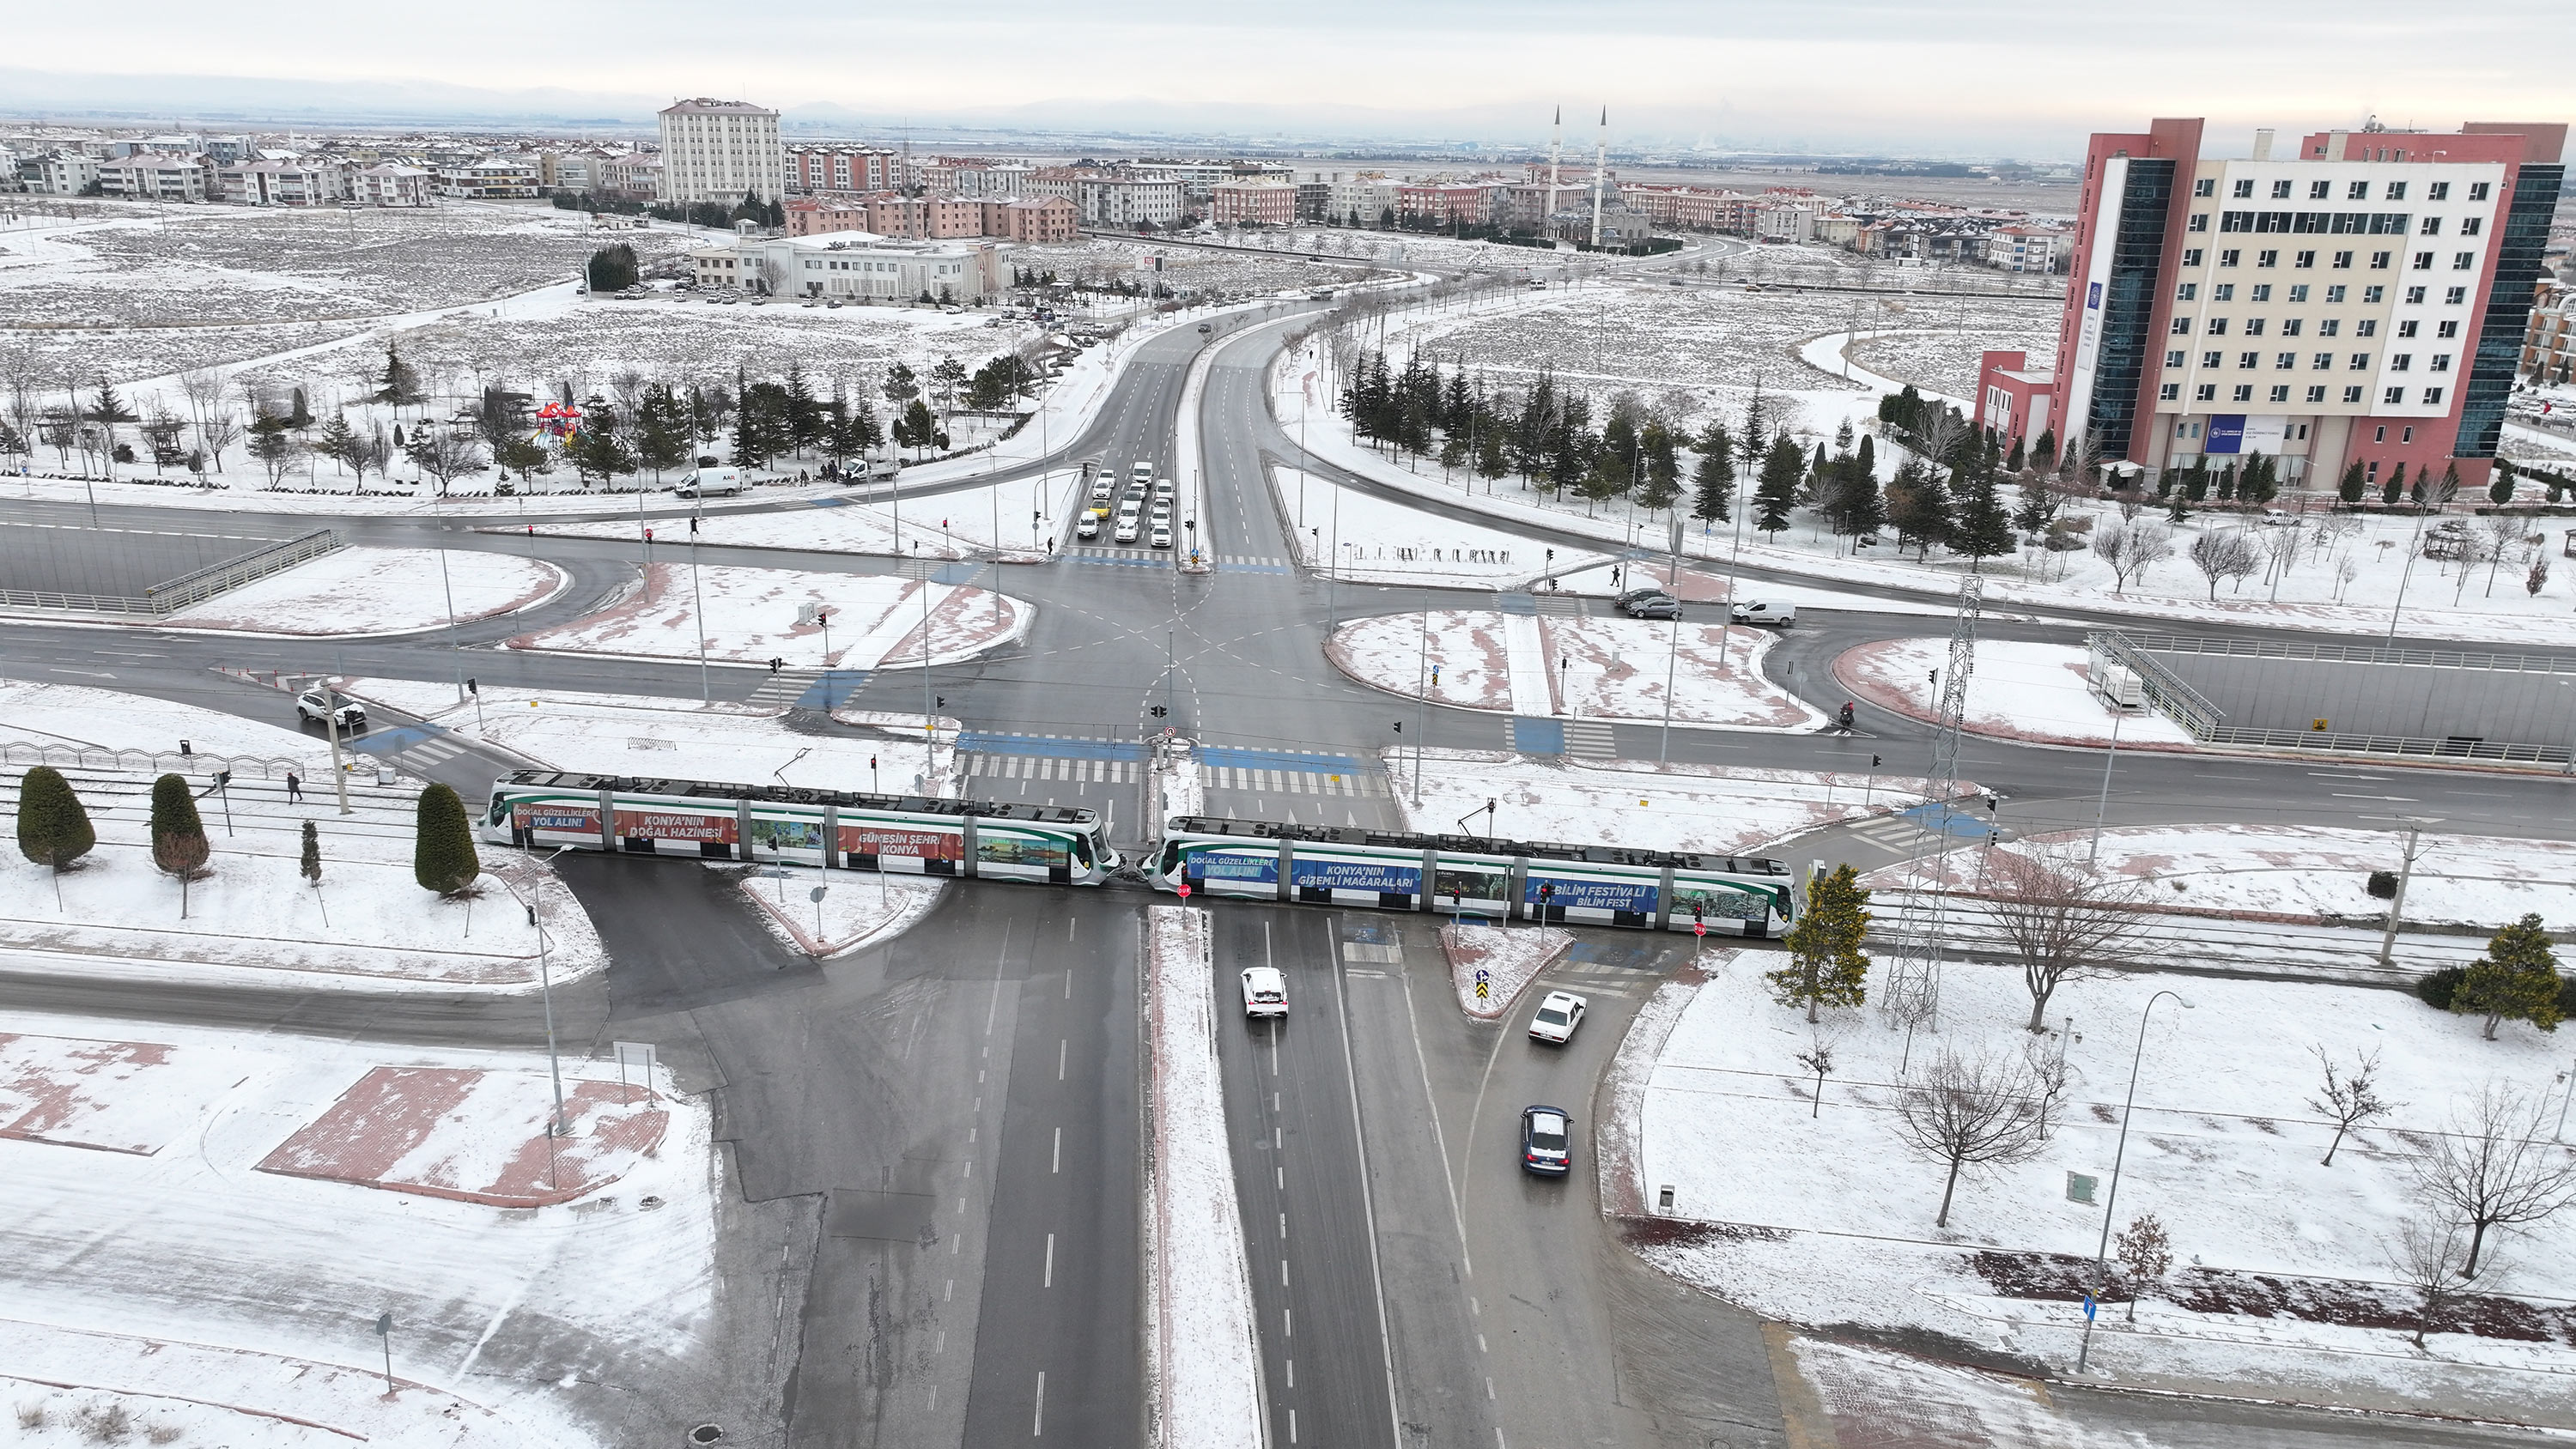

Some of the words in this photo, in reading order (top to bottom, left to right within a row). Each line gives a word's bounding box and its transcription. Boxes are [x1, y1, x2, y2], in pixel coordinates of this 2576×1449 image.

[533, 817, 553, 827] YOL
[555, 817, 582, 827] ALIN!
[645, 815, 705, 826] KONYA'NIN
[629, 826, 668, 838] DOĞAL
[671, 826, 723, 838] HAZİNESİ
[859, 832, 908, 845] GÜNEŞİN
[908, 834, 942, 845] ŞEHRİ
[883, 845, 919, 854] KONYA
[1190, 856, 1217, 864] DOĞAL
[1218, 857, 1273, 866] GÜZELLİKLERE
[1206, 866, 1227, 875] YOL
[1229, 866, 1258, 876] ALIN!
[1327, 865, 1385, 876] KONYA'NIN
[1299, 875, 1341, 885] GİZEMLİ
[1342, 876, 1413, 888] MAĞARALARI
[1555, 883, 1585, 895] BİLİM
[1588, 885, 1646, 897] FESTİVALİ
[1577, 895, 1604, 906] BİLİM
[1606, 898, 1631, 907] FEST
[1694, 925, 1705, 933] DUR
